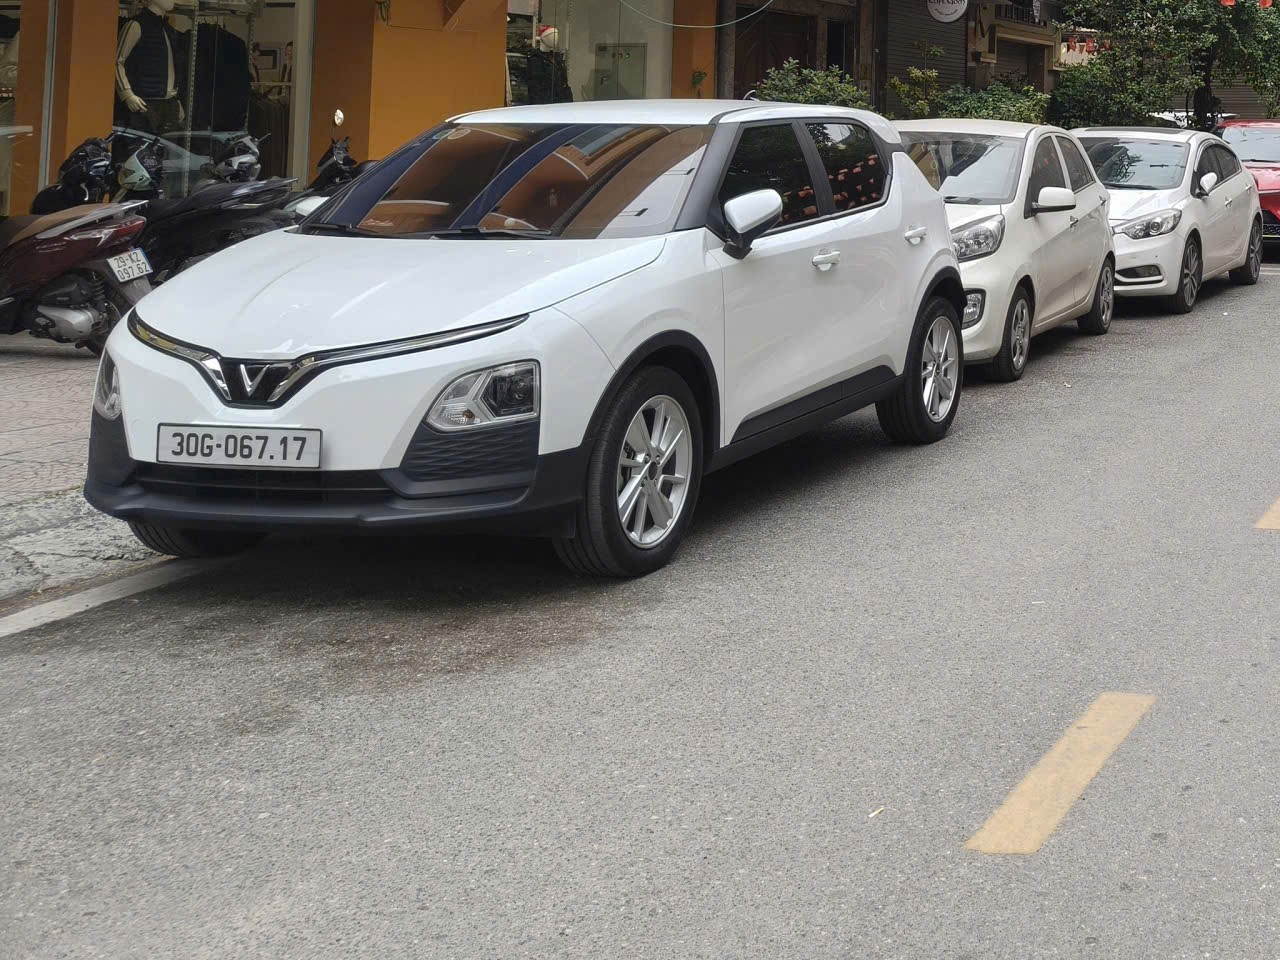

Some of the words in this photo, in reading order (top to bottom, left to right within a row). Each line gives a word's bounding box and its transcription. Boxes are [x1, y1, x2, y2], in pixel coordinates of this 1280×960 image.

[113, 251, 142, 269] 29-K2
[116, 261, 150, 280] 097.62
[171, 432, 307, 461] 30G-067.17
